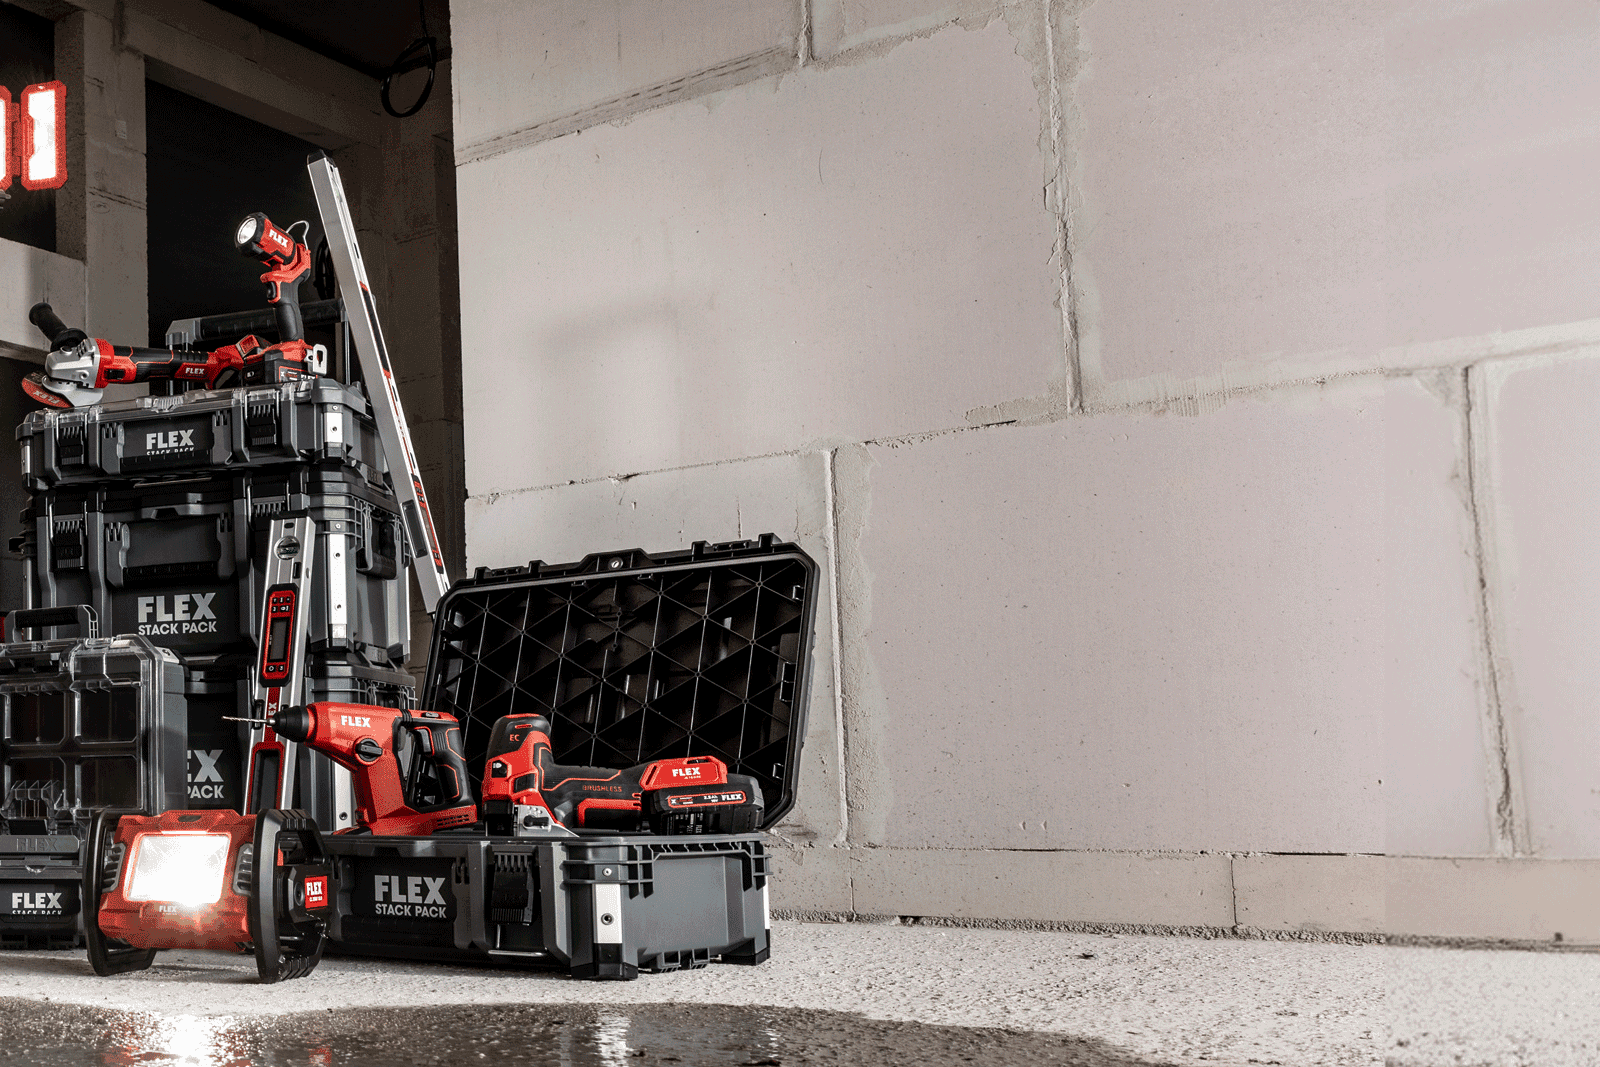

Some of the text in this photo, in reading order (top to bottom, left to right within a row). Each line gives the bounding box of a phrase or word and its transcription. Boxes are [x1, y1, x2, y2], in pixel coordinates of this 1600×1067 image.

[269, 229, 288, 247] FLEX
[33, 391, 59, 404] FLEX
[146, 429, 194, 449] FLEX
[138, 593, 216, 623] FLEX
[138, 621, 217, 636] STACK PACK
[341, 715, 371, 728] FLEX
[672, 767, 701, 777] FLEX
[17, 838, 57, 851] FLEX
[307, 882, 322, 895] FLEX
[374, 875, 446, 905] FLEX
[12, 893, 62, 908] FLEX
[375, 903, 447, 918] STACK PACK
